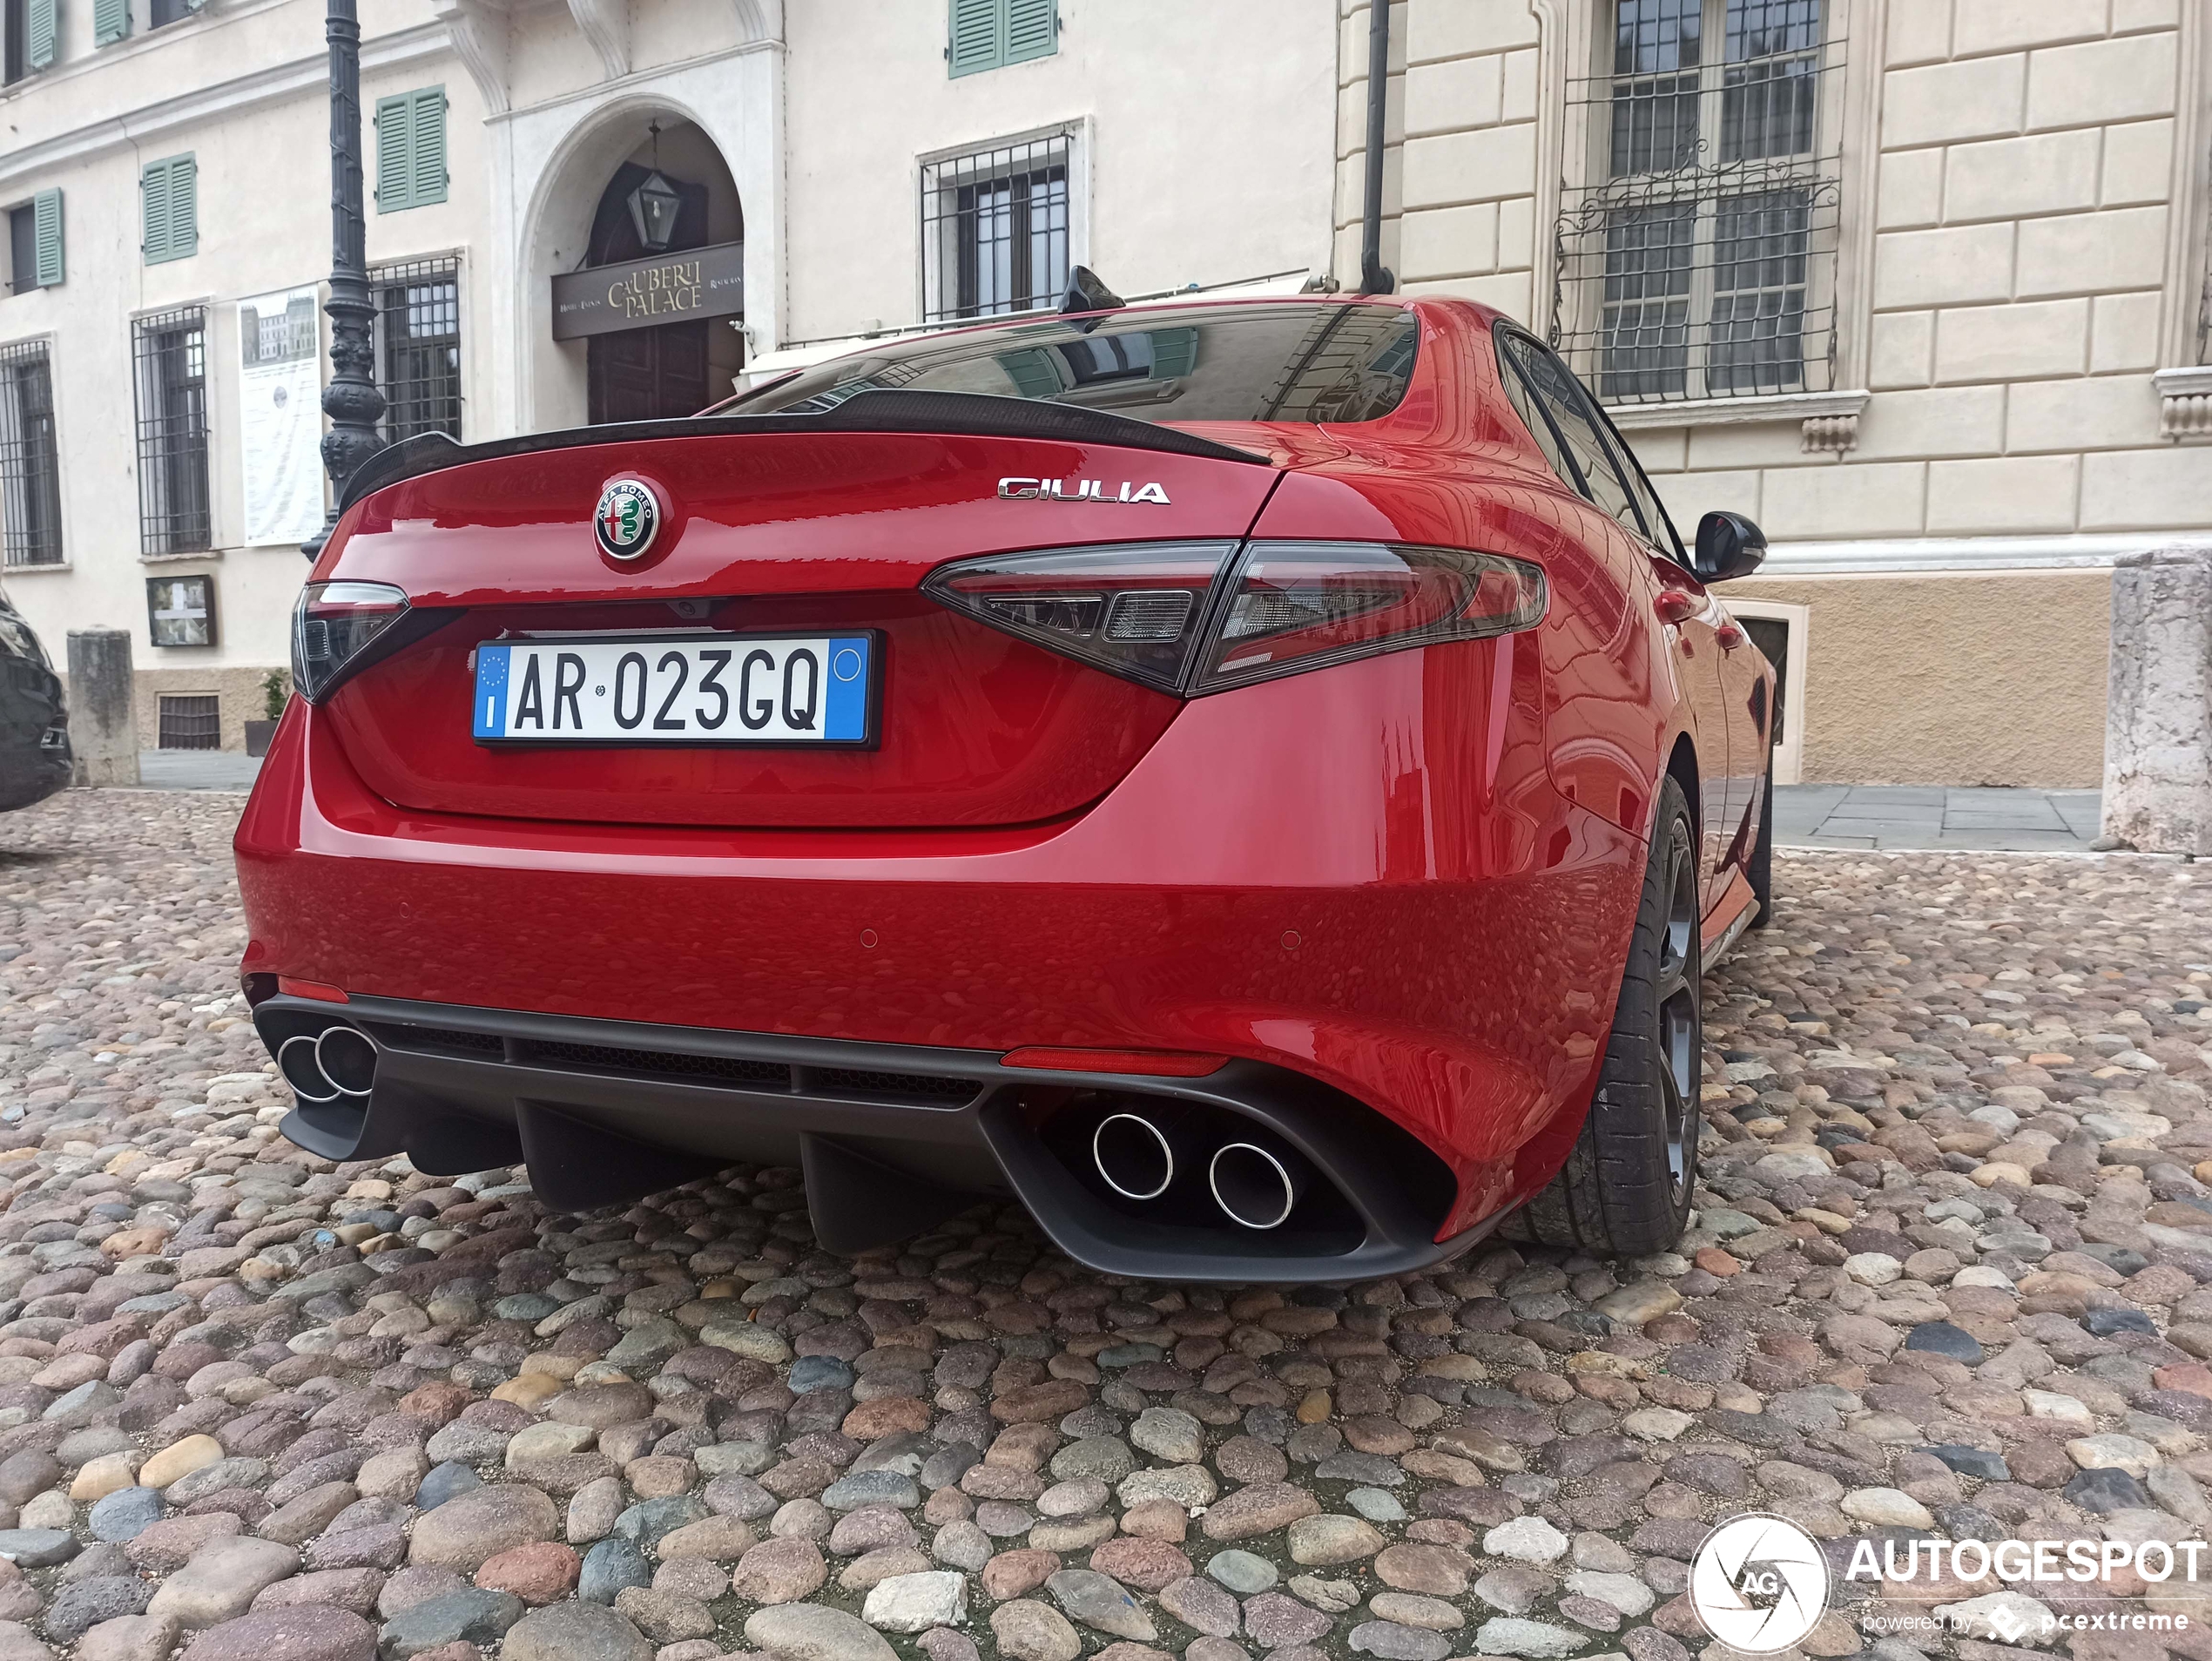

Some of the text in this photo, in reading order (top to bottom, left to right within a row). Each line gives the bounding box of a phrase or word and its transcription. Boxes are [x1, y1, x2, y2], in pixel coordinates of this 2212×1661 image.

[625, 285, 702, 318] PALACE
[598, 485, 652, 521] ALFA ROMEO
[997, 476, 1171, 505] GIULIA
[514, 647, 819, 731] AR 023GQ
